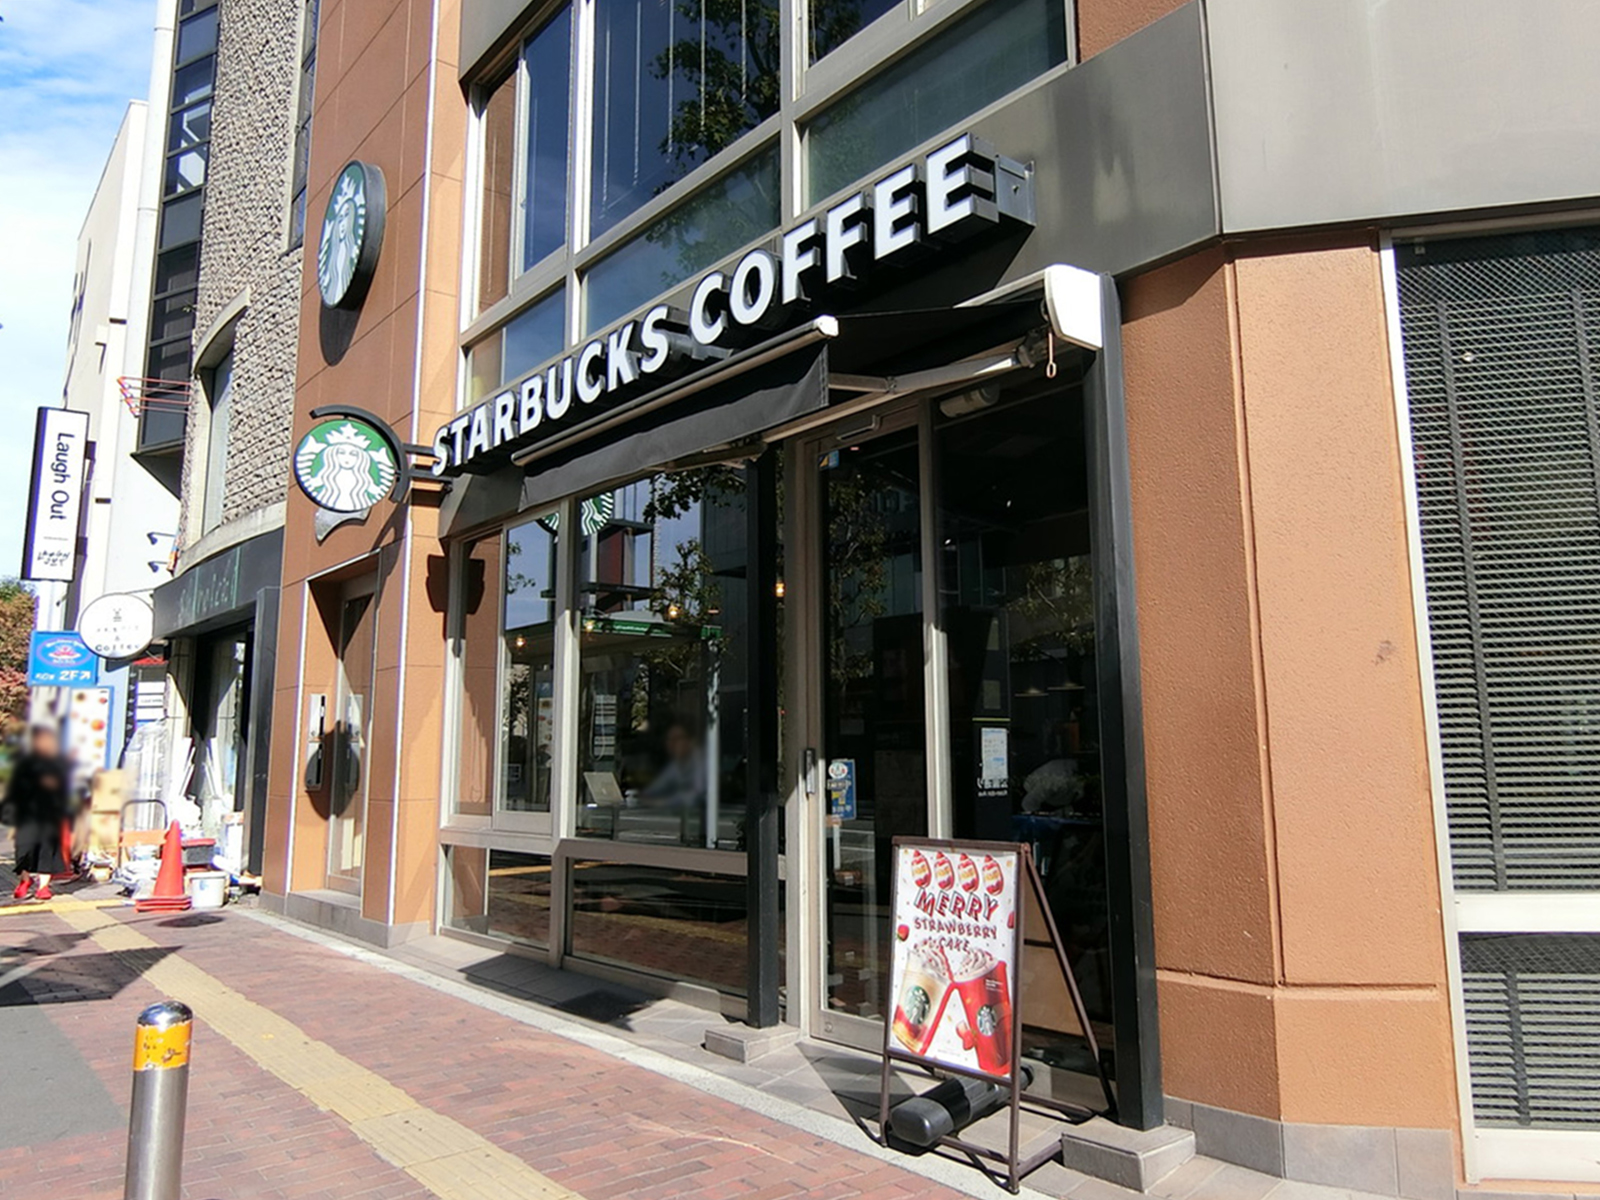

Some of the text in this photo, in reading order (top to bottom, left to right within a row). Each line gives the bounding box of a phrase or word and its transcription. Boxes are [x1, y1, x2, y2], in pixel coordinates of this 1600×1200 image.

[431, 132, 998, 477] STARBUCKS COFFEE
[50, 432, 75, 520] Laugh Out
[913, 887, 999, 922] MERRY
[914, 915, 998, 940] STRAWBERRY
[937, 936, 971, 954] CAKE
